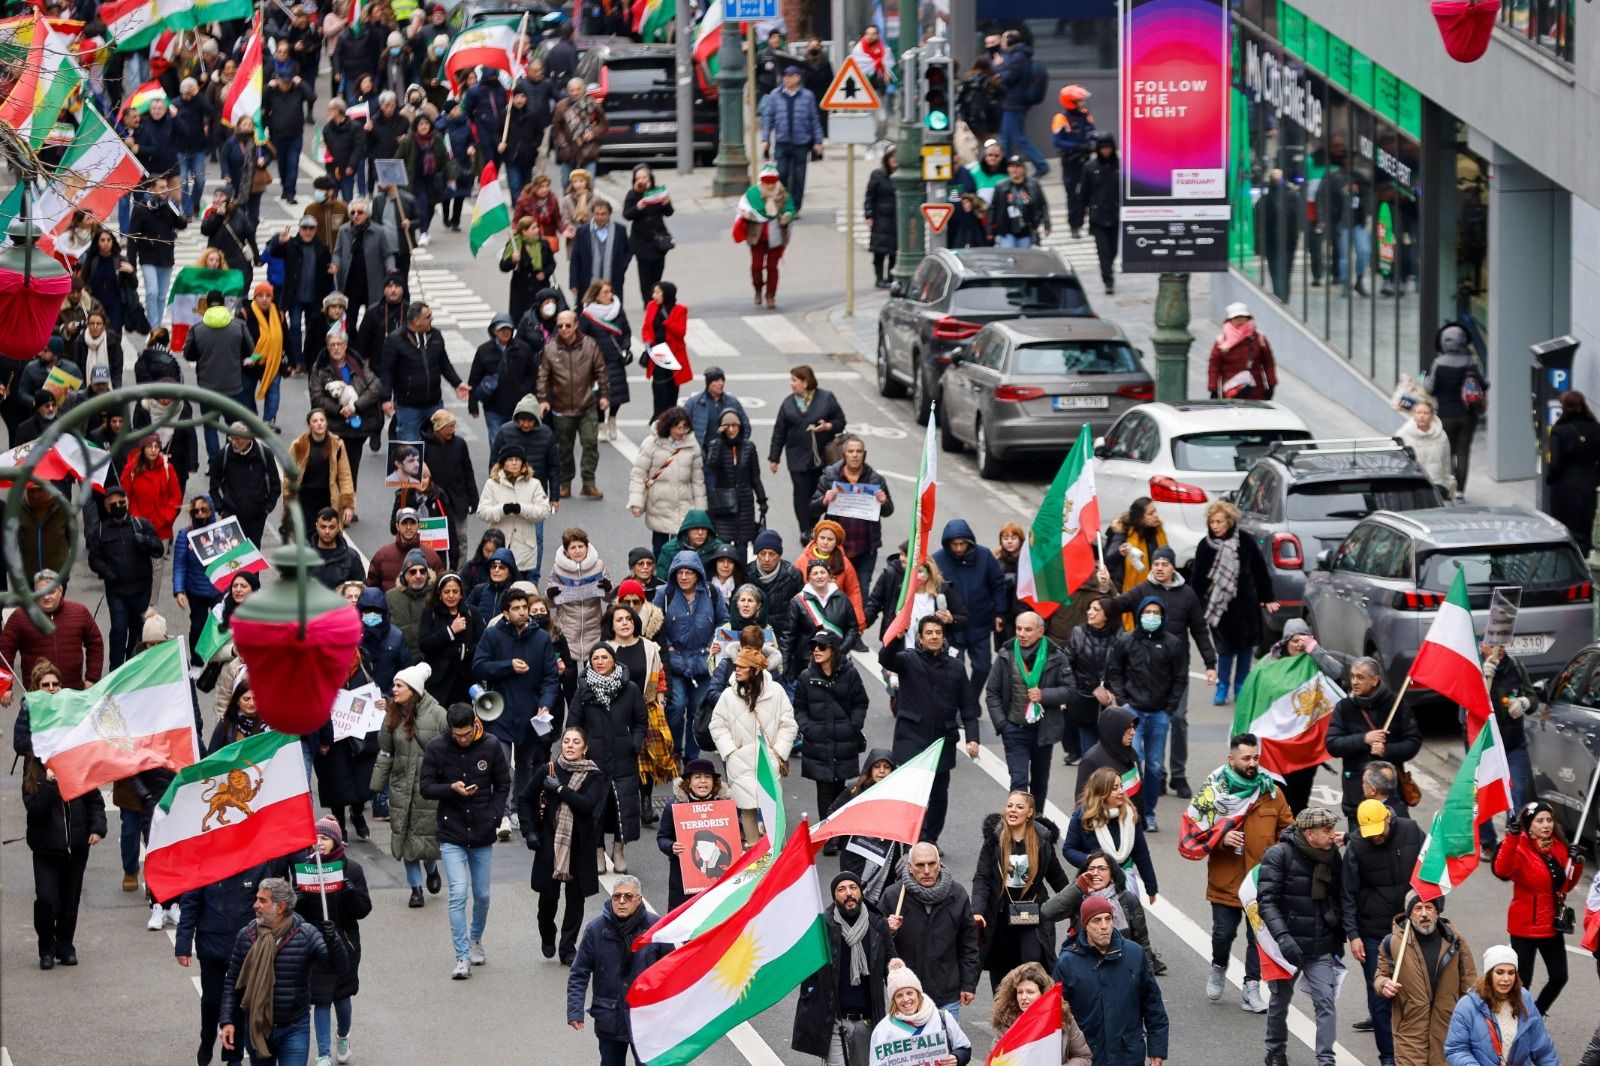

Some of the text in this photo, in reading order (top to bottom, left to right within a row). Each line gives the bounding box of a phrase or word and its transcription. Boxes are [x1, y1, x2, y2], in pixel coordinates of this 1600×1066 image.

[1134, 80, 1207, 92] FOLLOW
[1134, 93, 1168, 105] THE
[1134, 106, 1188, 118] LIGHT
[1552, 369, 1567, 389] P
[1551, 407, 1564, 427] P
[333, 719, 352, 732] oup
[692, 803, 714, 813] IRGC
[680, 818, 730, 830] TERRORIST
[304, 865, 333, 874] Woan
[304, 884, 338, 892] Freeom
[874, 1033, 946, 1061] FREE ALL
